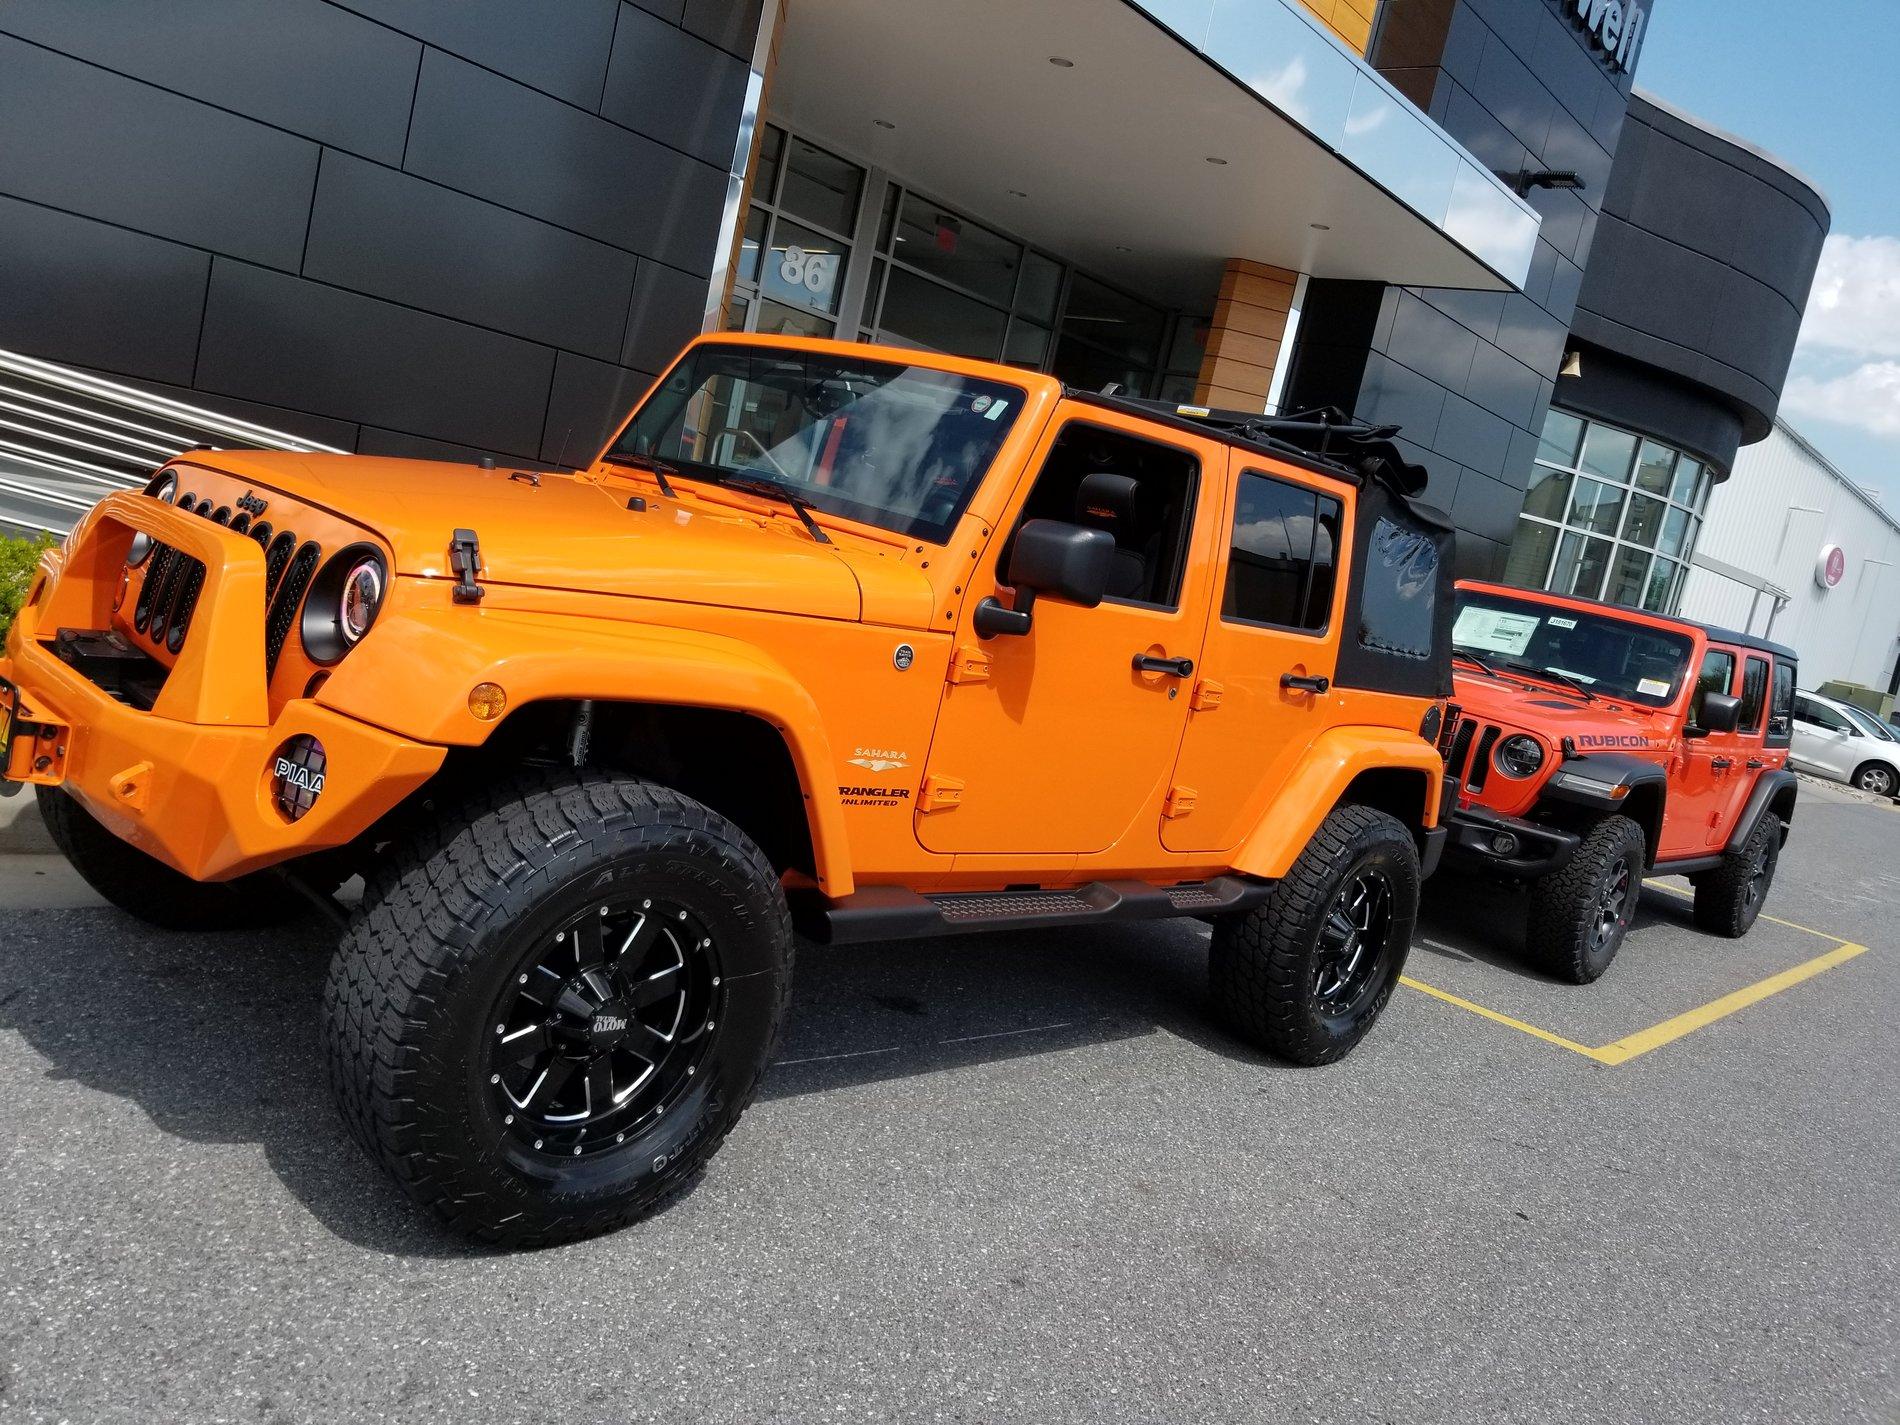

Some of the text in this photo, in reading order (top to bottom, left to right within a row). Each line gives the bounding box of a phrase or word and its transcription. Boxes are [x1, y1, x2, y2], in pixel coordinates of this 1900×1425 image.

[781, 246, 827, 293] 86
[236, 490, 268, 519] Jeep
[1579, 735, 1649, 747] RUBICON
[855, 748, 907, 760] SAHARA
[274, 758, 324, 795] PIAA
[838, 787, 910, 798] RANGLER
[593, 1018, 628, 1033] MOTO
